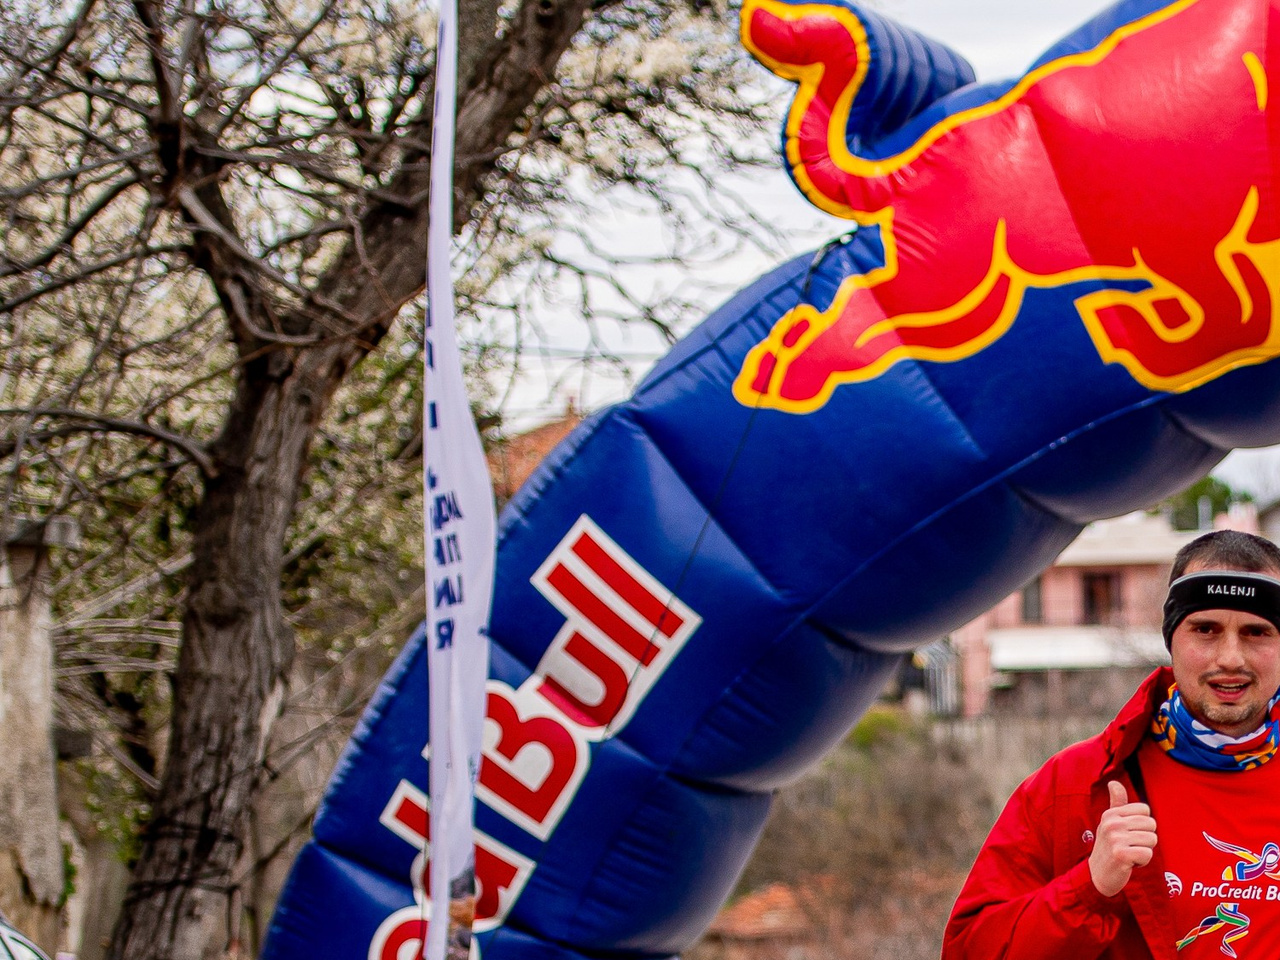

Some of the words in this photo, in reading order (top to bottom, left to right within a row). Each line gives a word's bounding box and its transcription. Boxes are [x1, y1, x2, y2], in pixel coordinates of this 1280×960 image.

[1207, 584, 1255, 597] KALENJI
[475, 525, 694, 832] Bull
[1190, 881, 1263, 900] ProCredit
